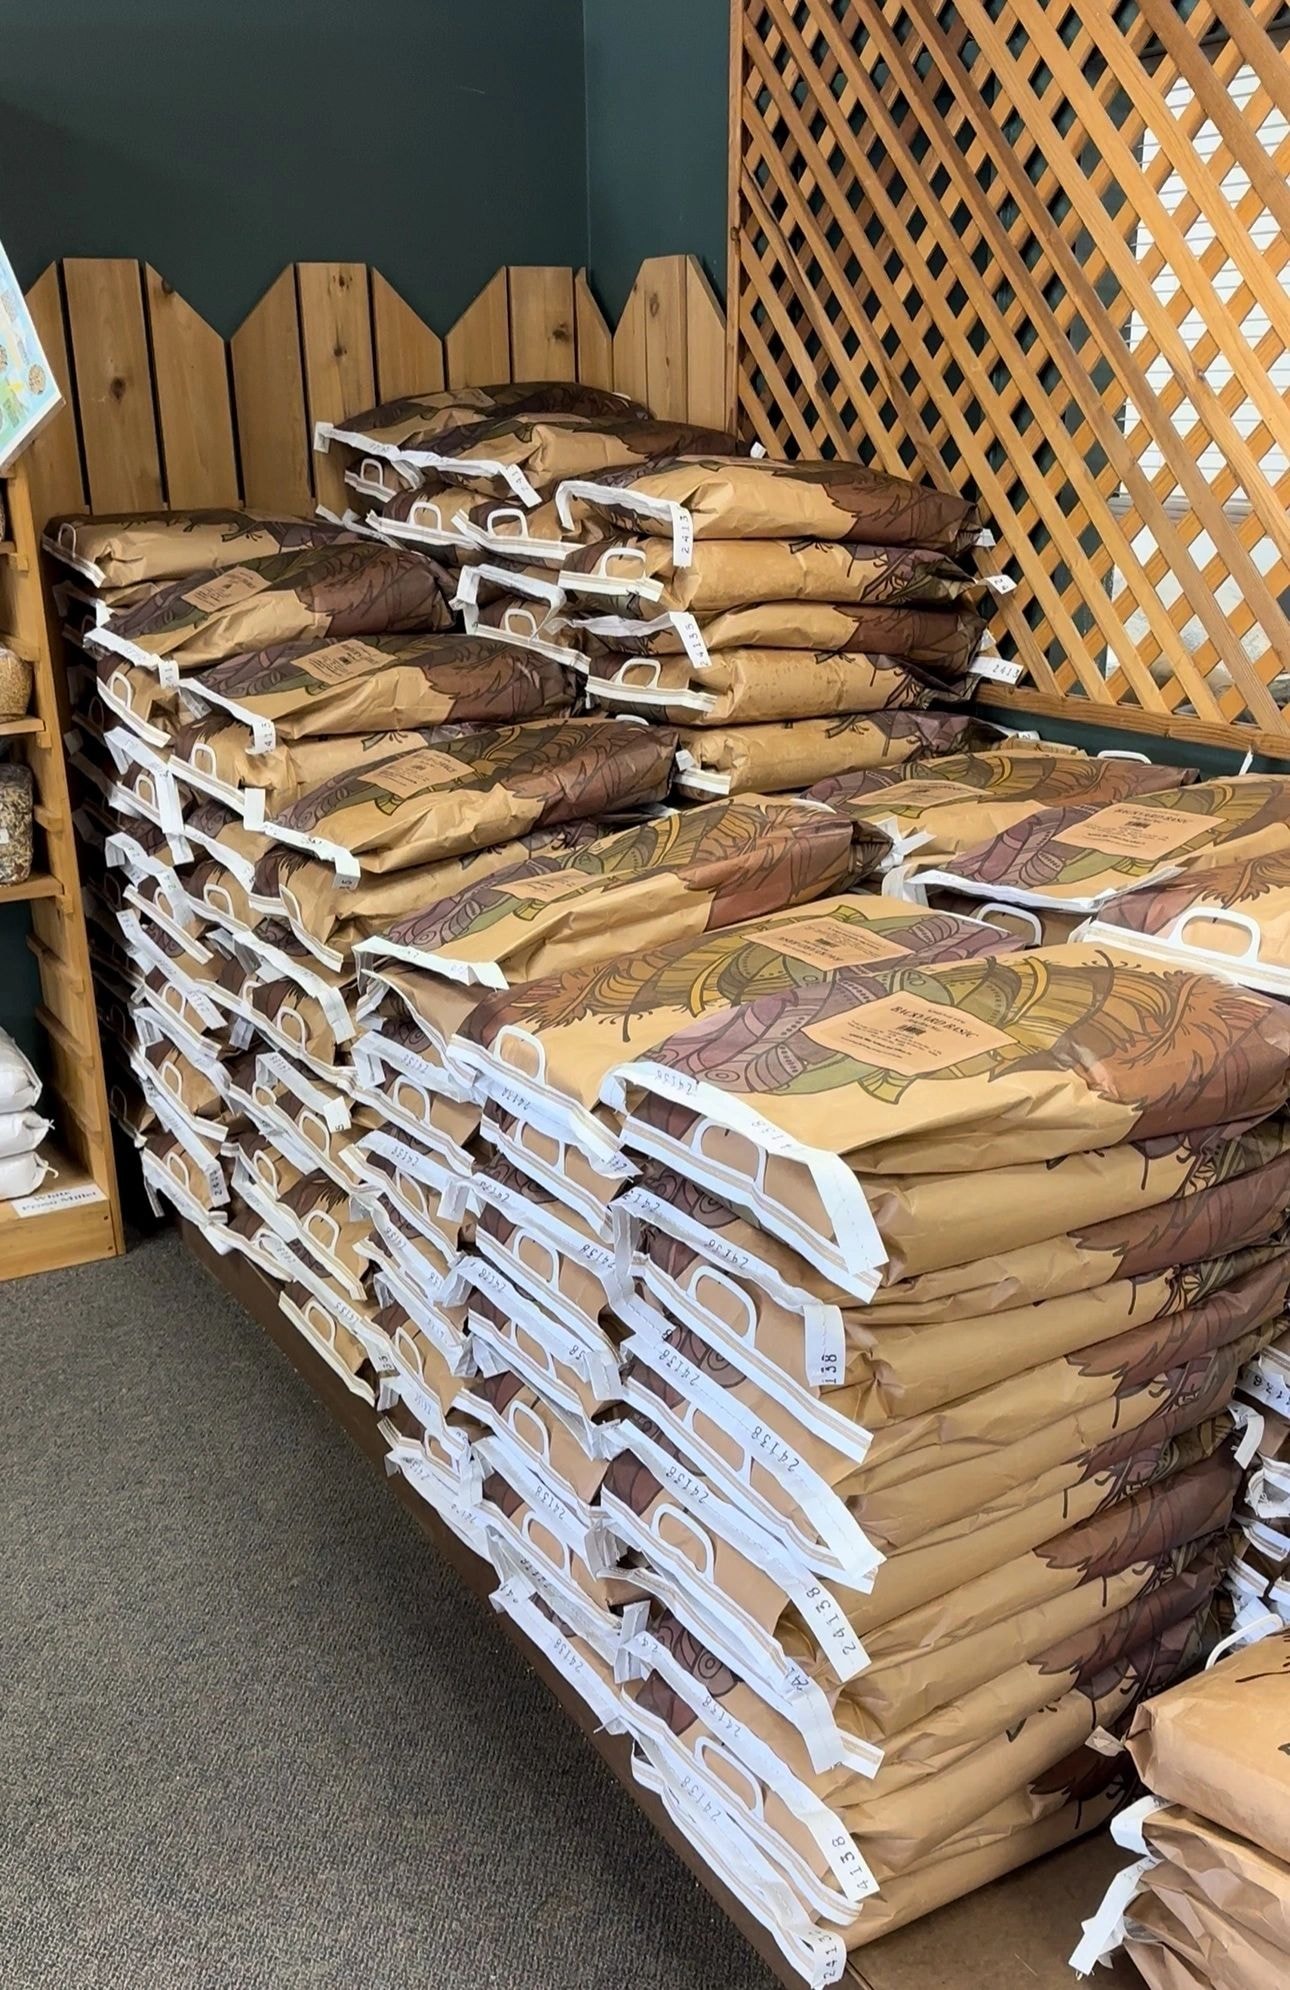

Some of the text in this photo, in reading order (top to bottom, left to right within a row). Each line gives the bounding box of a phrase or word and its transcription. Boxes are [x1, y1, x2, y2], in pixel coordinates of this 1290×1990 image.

[680, 515, 691, 554] 2413
[658, 1349, 701, 1387] 24138
[821, 1353, 838, 1384] 138
[751, 1425, 800, 1473] 24138
[535, 1485, 566, 1521] 24138
[665, 1466, 710, 1504] 24138
[806, 1586, 857, 1656] 24138
[553, 1638, 584, 1673] 24138
[701, 1695, 743, 1738] 24138
[681, 1776, 722, 1825] 24138
[832, 1836, 869, 1891] 4138
